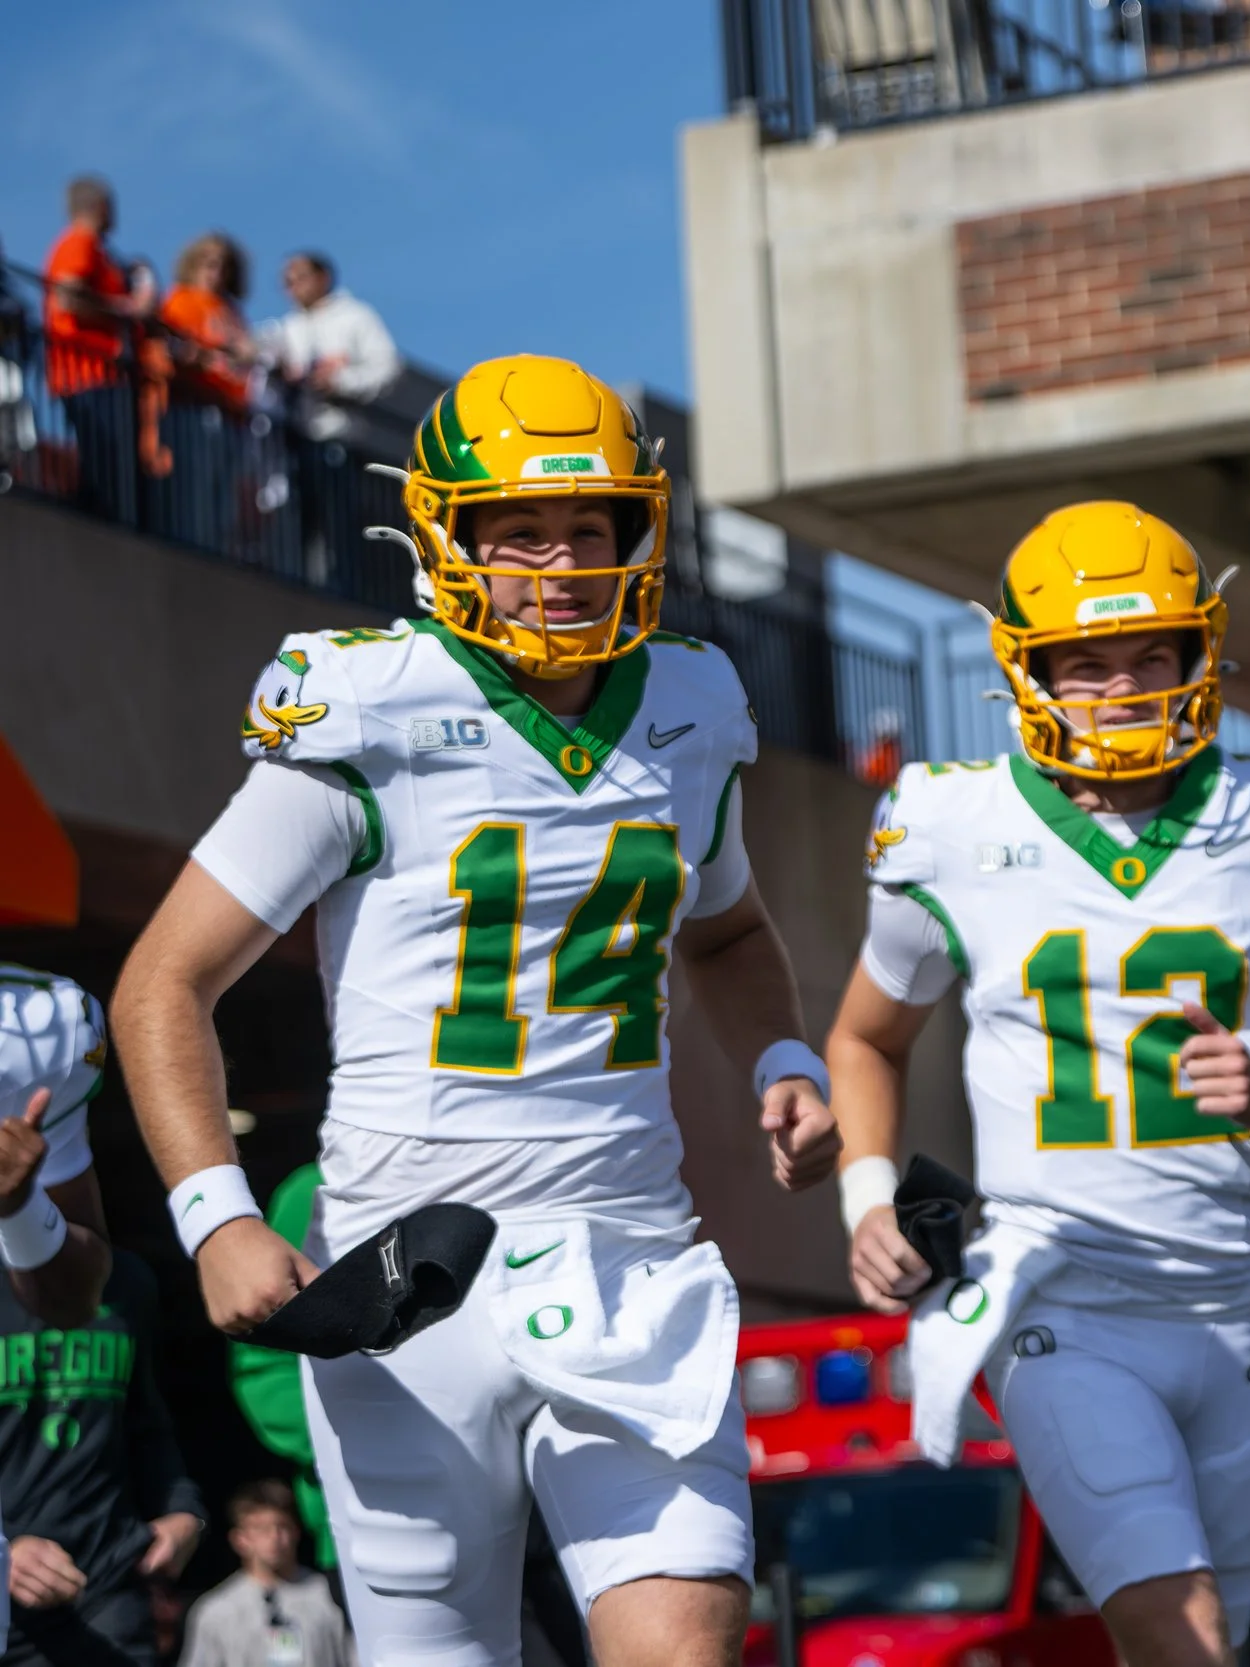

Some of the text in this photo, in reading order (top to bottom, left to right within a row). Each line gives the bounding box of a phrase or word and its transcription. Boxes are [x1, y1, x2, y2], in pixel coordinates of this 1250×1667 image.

[541, 456, 594, 474] OREGON
[1093, 596, 1140, 615] OREGON
[560, 745, 592, 776] O
[1112, 857, 1146, 887] O
[430, 820, 686, 1076] 14
[0, 1328, 135, 1388] REGON
